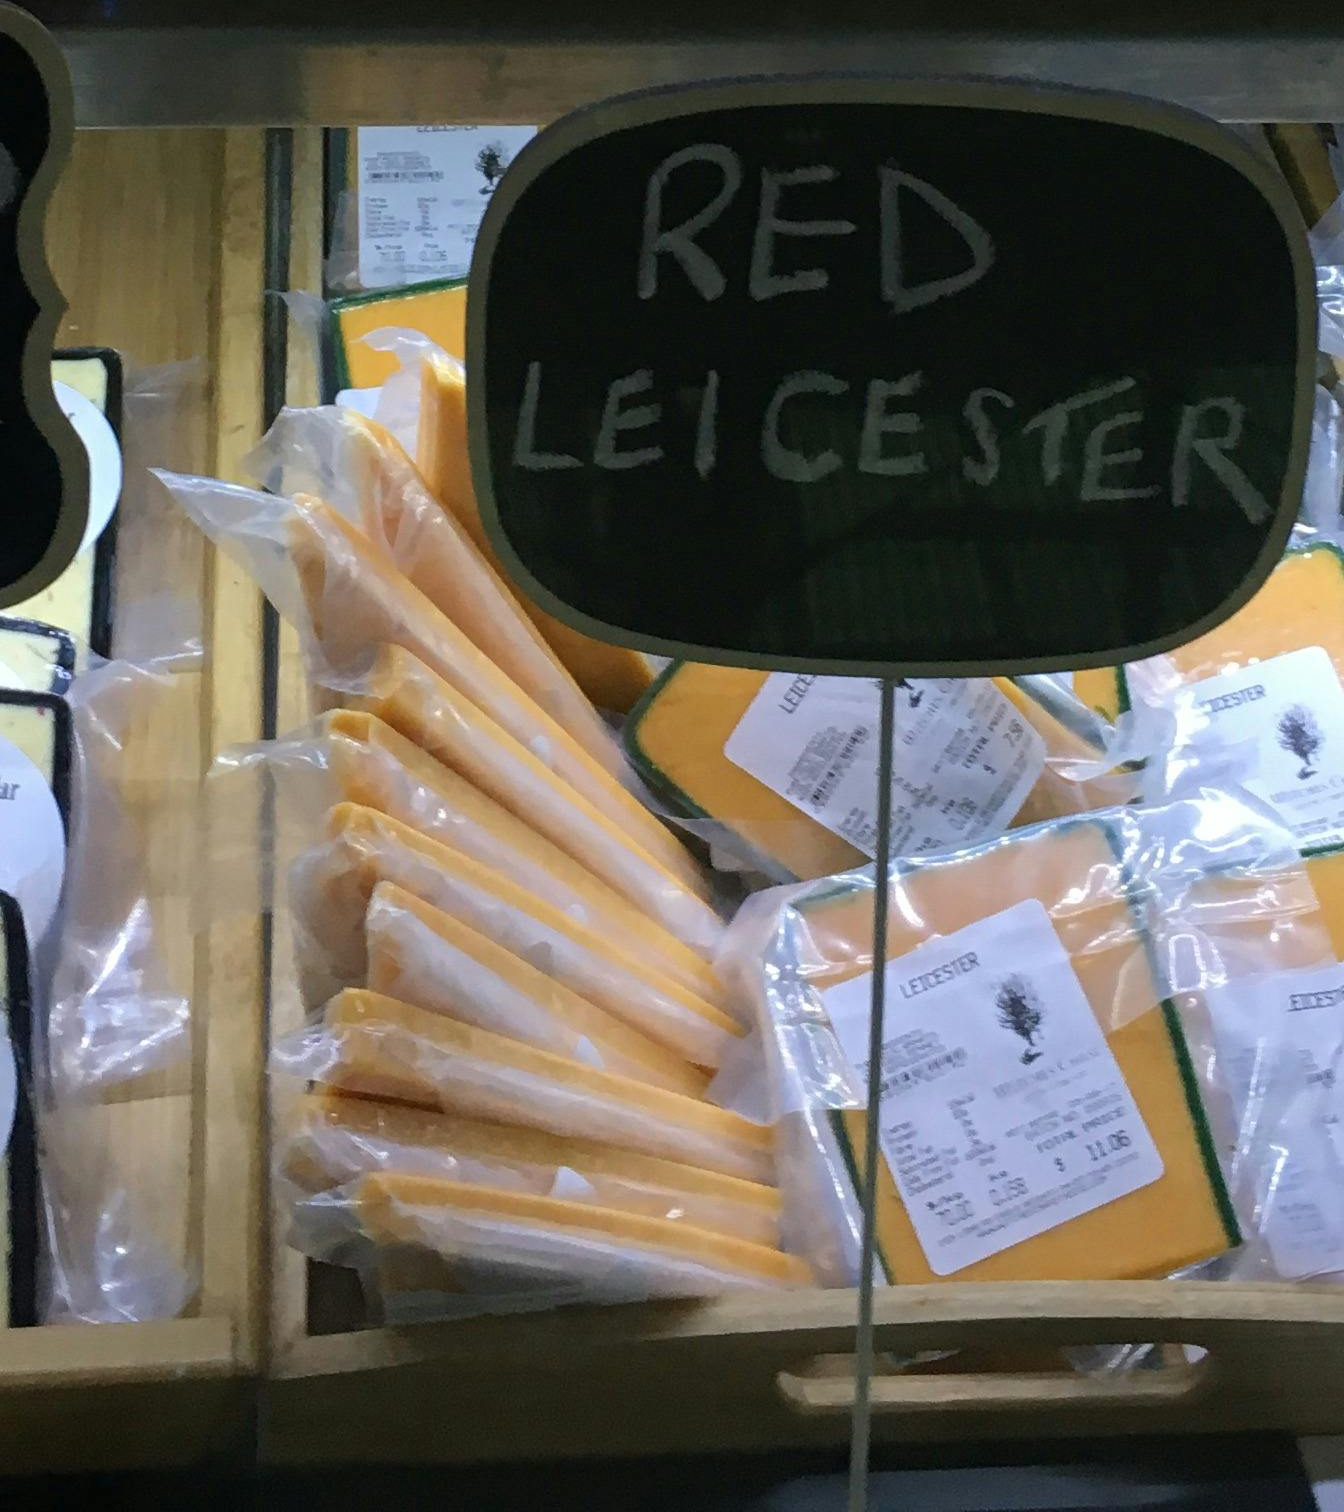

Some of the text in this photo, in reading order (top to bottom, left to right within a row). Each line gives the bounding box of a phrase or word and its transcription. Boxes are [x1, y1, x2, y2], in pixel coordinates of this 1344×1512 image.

[637, 142, 994, 314] RED
[512, 360, 1273, 525] LEICESTER
[899, 952, 981, 999] LEICESTER
